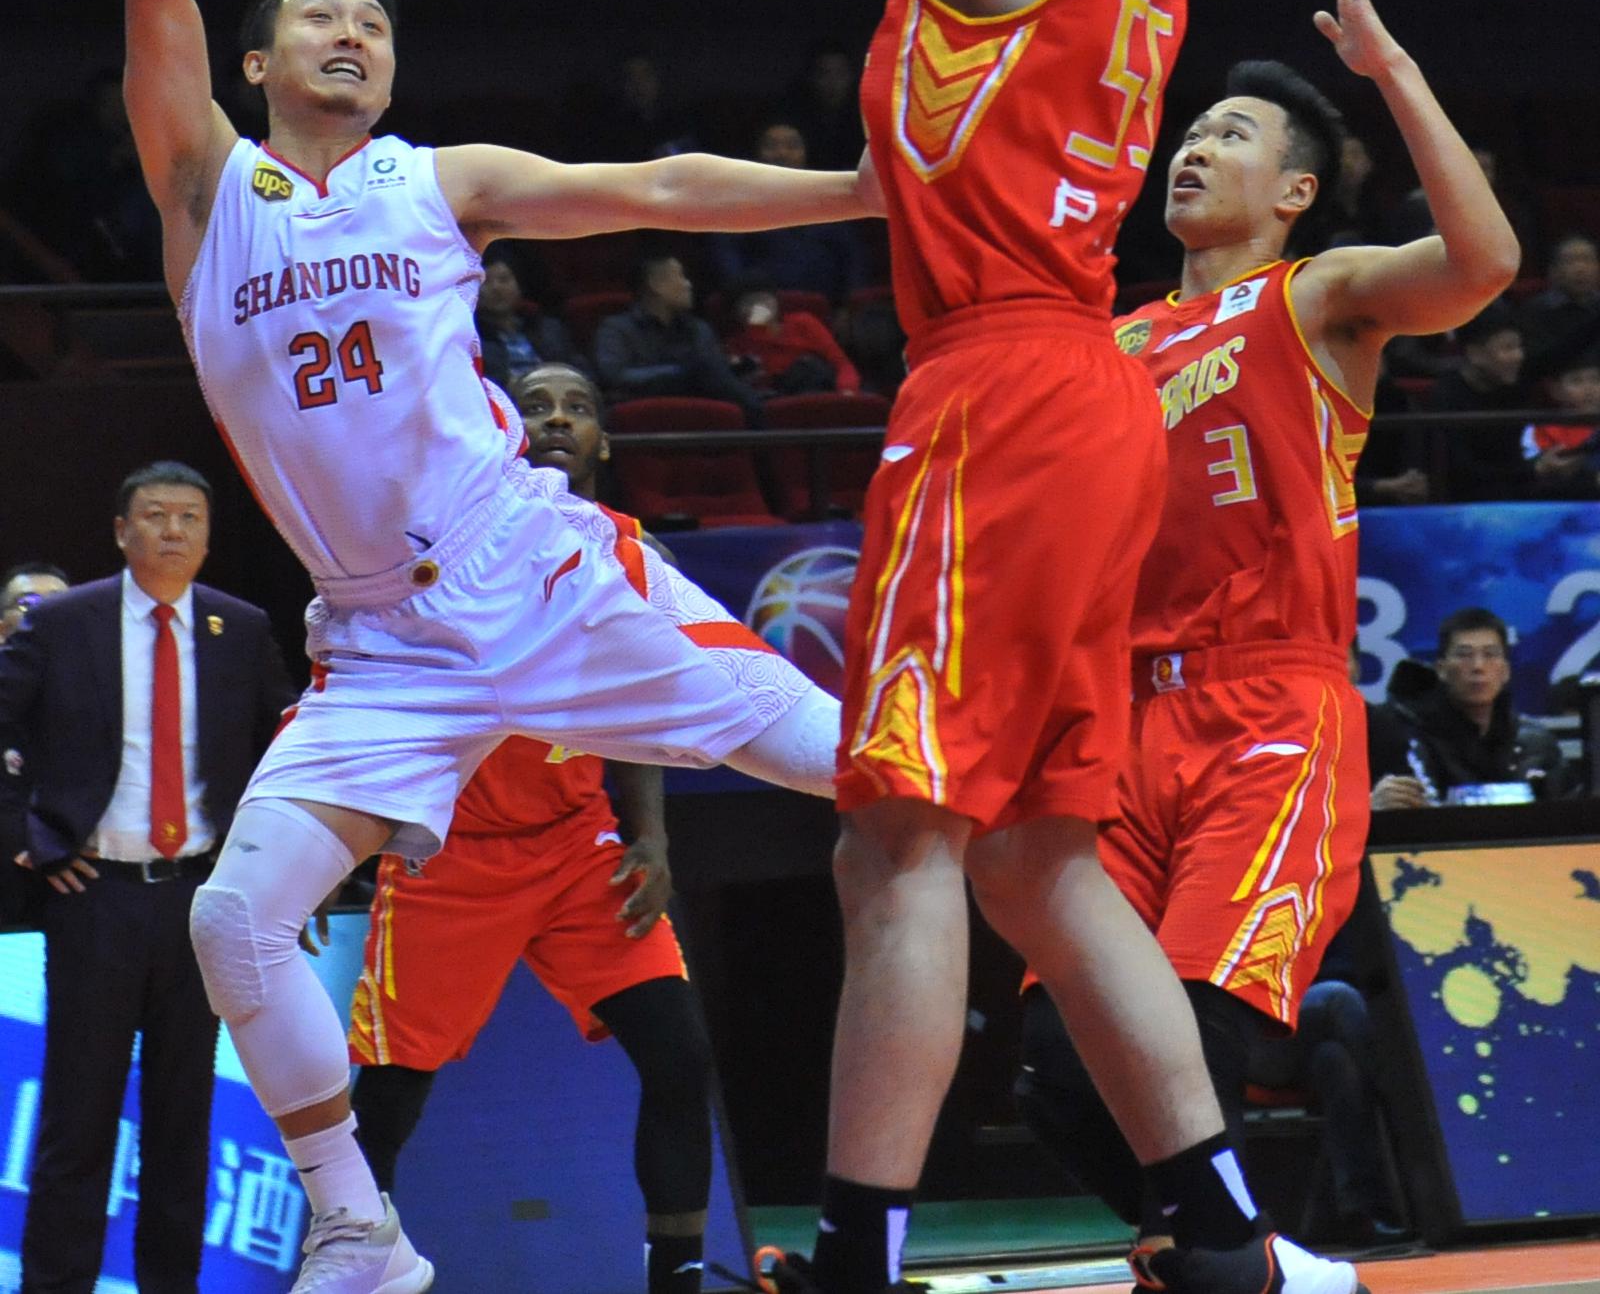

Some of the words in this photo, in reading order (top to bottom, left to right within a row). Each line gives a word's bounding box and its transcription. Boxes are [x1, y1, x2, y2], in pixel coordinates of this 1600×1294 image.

[254, 170, 292, 197] ups
[234, 252, 421, 326] SHANDONG
[288, 320, 383, 411] 24
[1156, 335, 1246, 431] ARDS
[1204, 424, 1258, 507] 3
